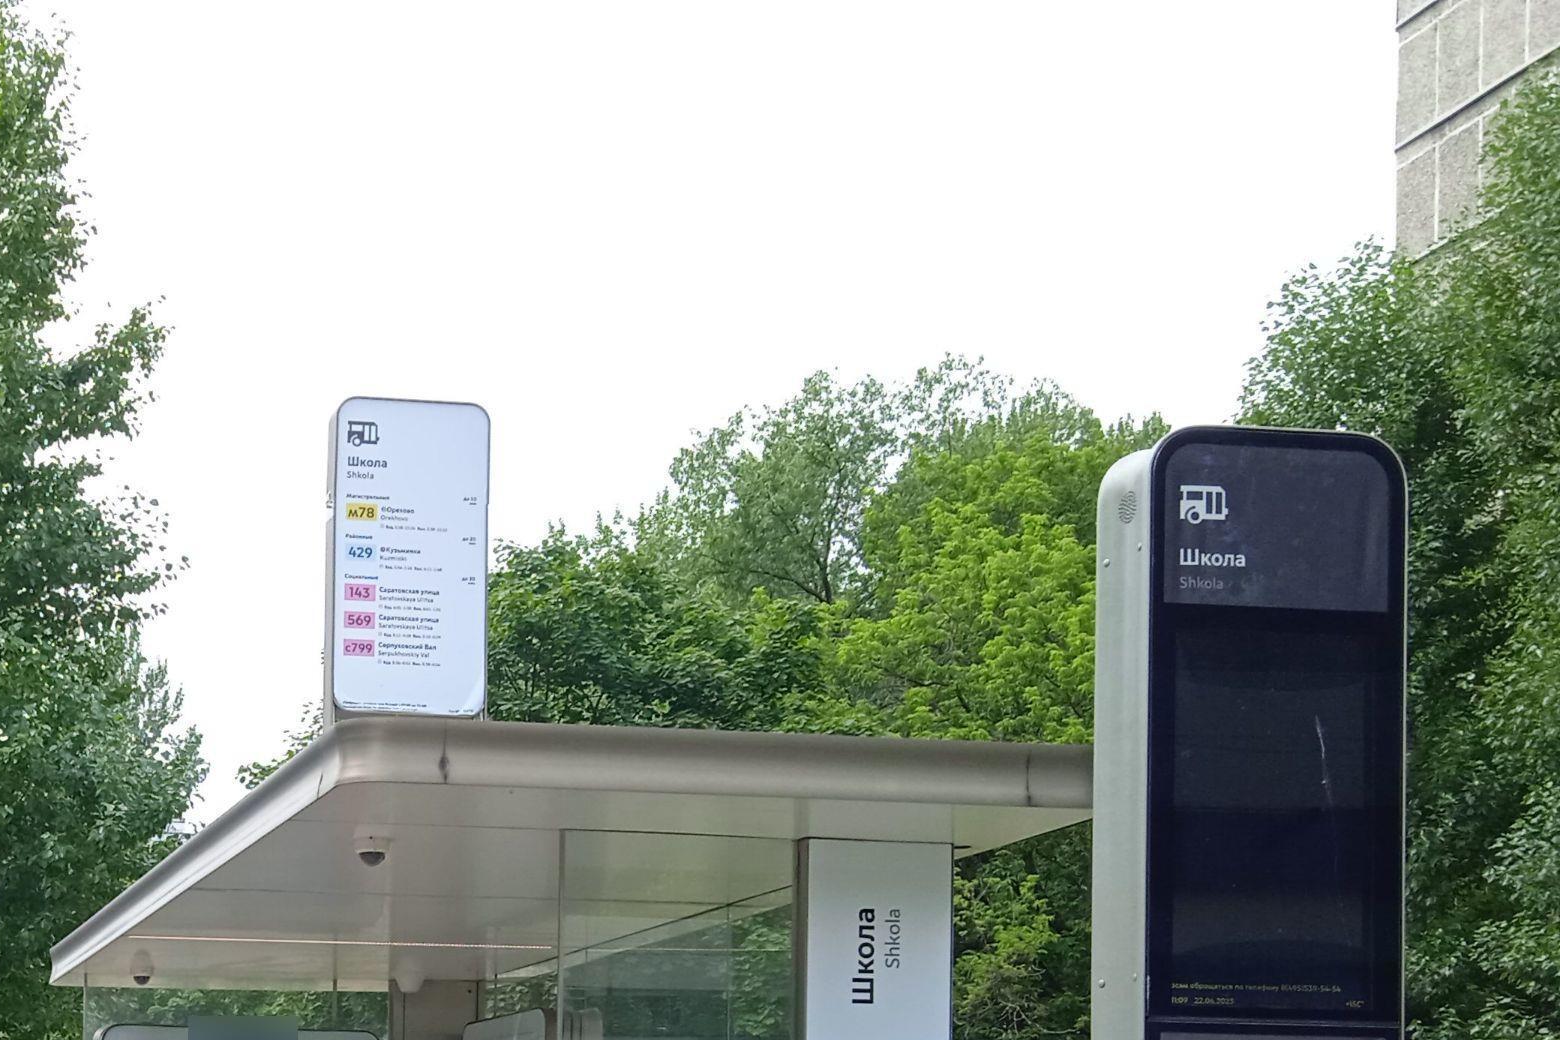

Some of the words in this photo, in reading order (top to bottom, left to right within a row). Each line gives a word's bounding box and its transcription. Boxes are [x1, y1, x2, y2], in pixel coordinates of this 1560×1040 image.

[347, 456, 388, 468] Школа
[346, 470, 374, 480] Shkola
[348, 546, 373, 559] 429
[1178, 547, 1247, 568] Школа
[1178, 576, 1224, 590] Shkola
[348, 586, 371, 599] 143
[347, 614, 372, 626] 569
[883, 908, 901, 969] Shkola
[851, 908, 875, 1004] Школа
